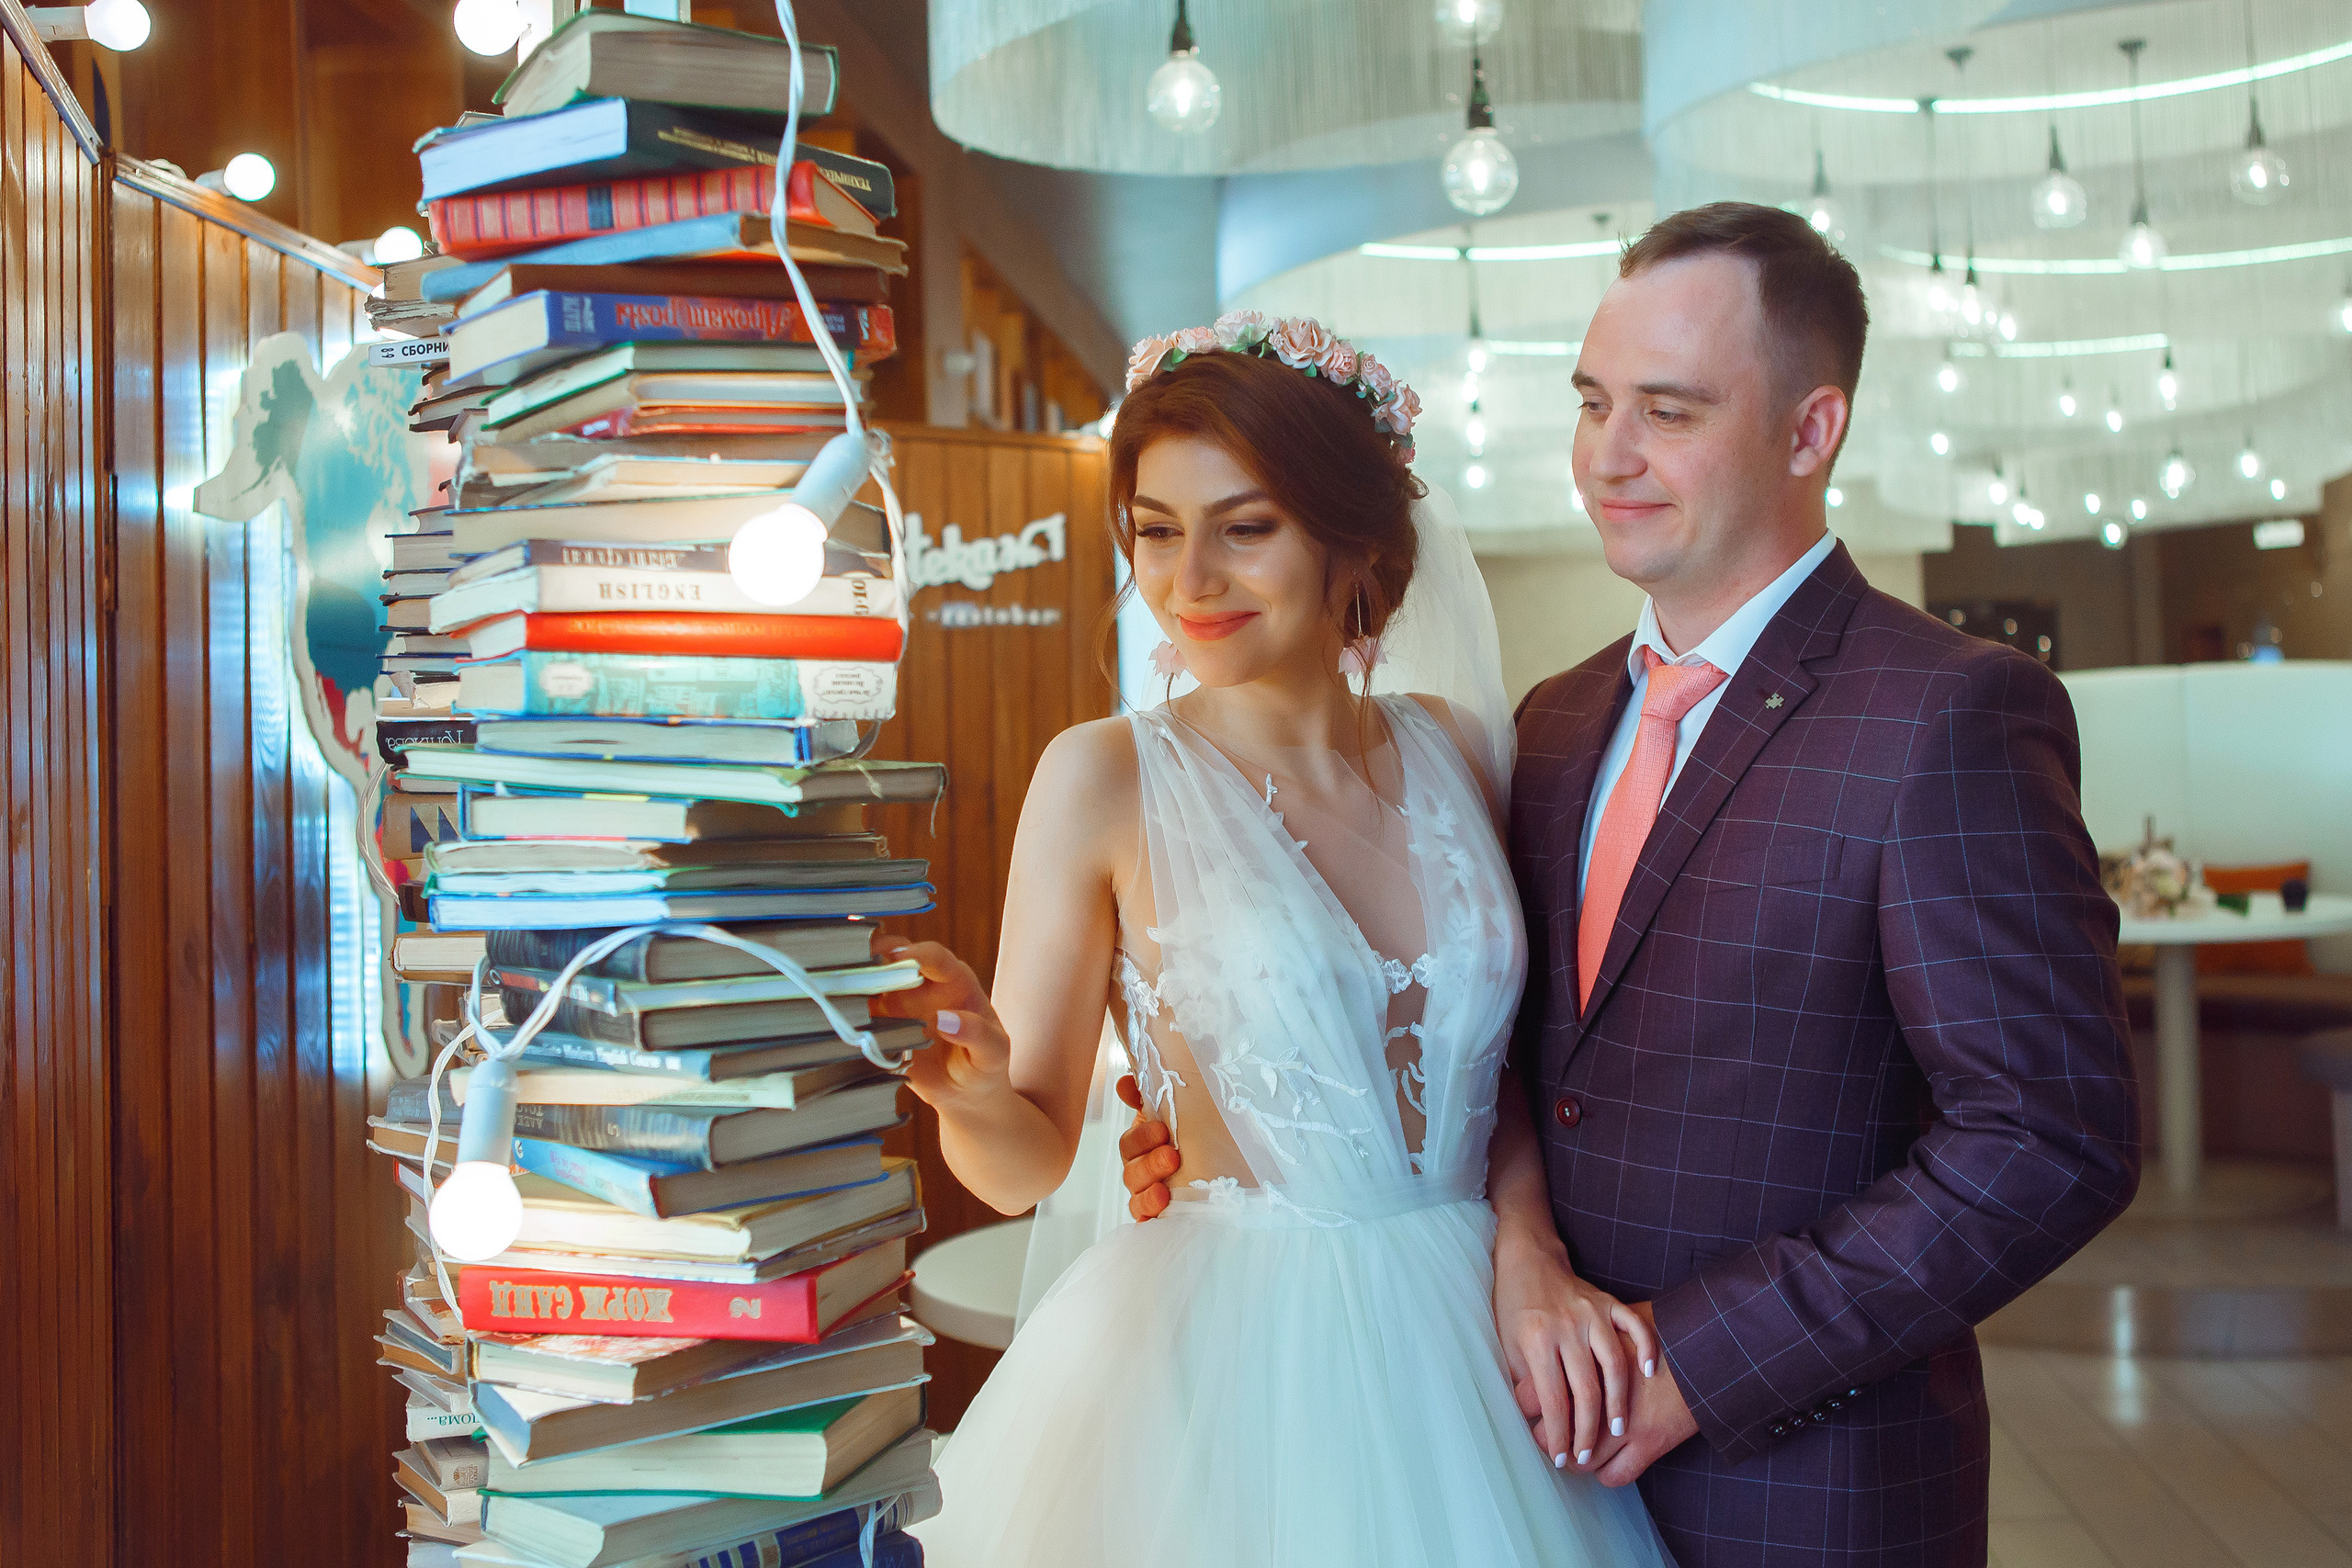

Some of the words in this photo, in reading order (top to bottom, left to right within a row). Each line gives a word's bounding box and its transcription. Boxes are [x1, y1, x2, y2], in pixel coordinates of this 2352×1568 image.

[598, 581, 701, 603] ENGLISH
[489, 1280, 574, 1320] САНД
[579, 1285, 674, 1323] ЖОРЖ
